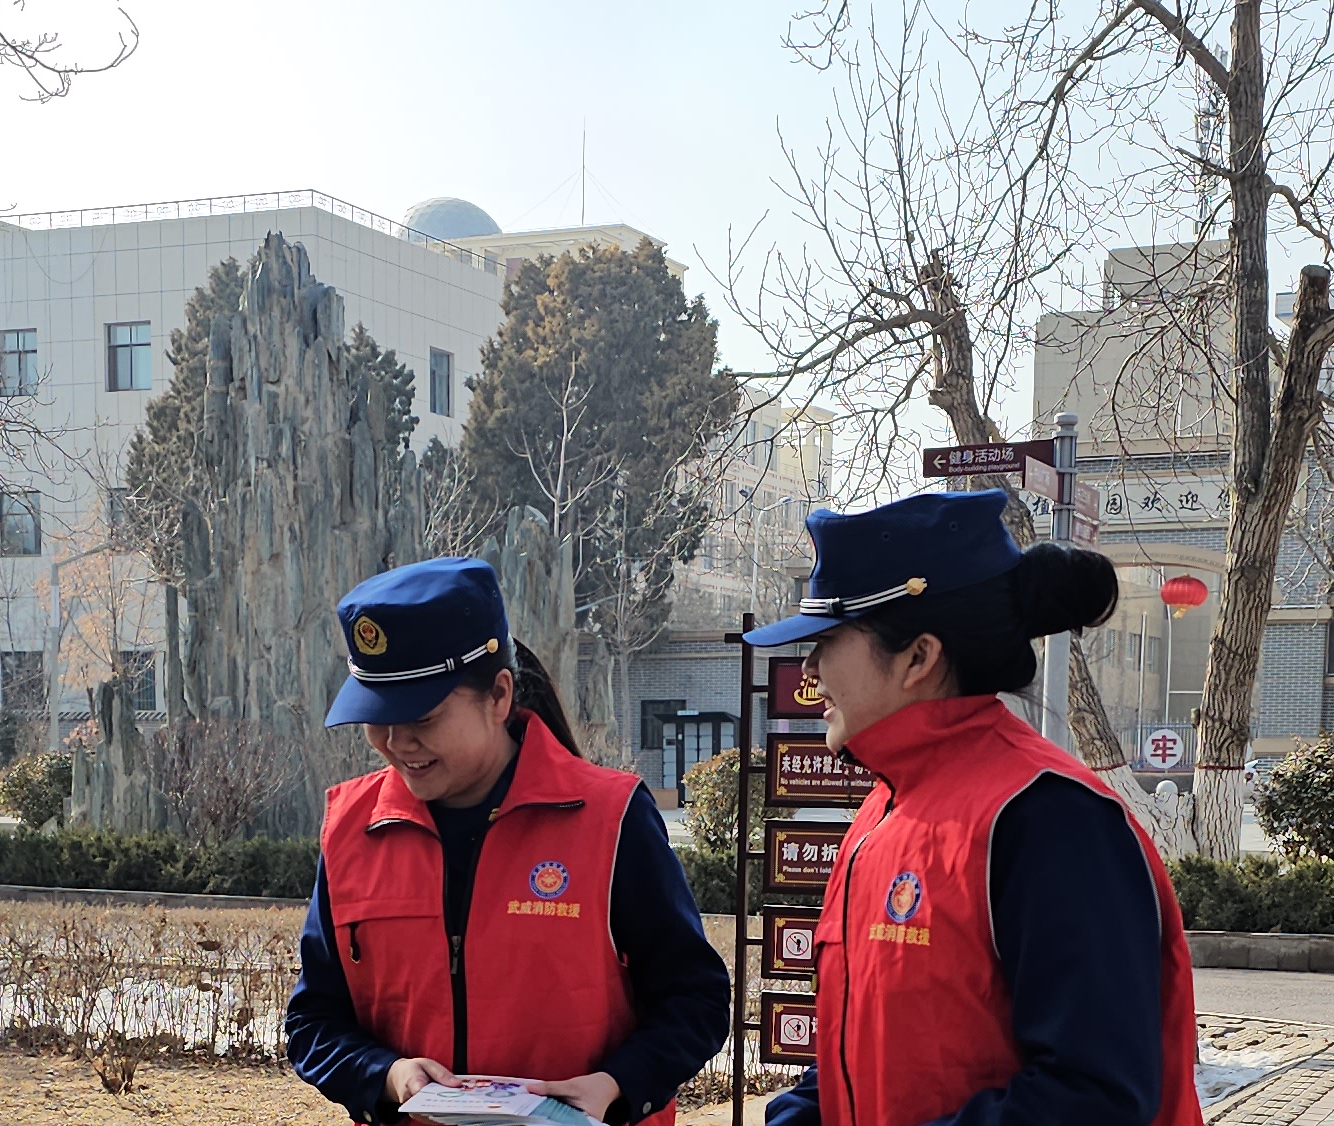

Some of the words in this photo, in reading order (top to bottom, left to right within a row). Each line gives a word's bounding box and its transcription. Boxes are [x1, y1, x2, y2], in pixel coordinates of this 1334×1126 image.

[948, 447, 1014, 465] 健身活动场
[948, 465, 987, 473] Body-building
[988, 462, 1021, 471] playground
[1150, 734, 1178, 764] 牢
[780, 777, 788, 785] No
[789, 778, 811, 786] vehicles
[821, 778, 843, 787] allowed
[850, 779, 872, 787] without
[781, 842, 838, 861] 请勿折
[782, 865, 802, 873] Please
[802, 866, 819, 874] don't
[819, 866, 832, 874] fold
[507, 900, 580, 918] 武威消防救援
